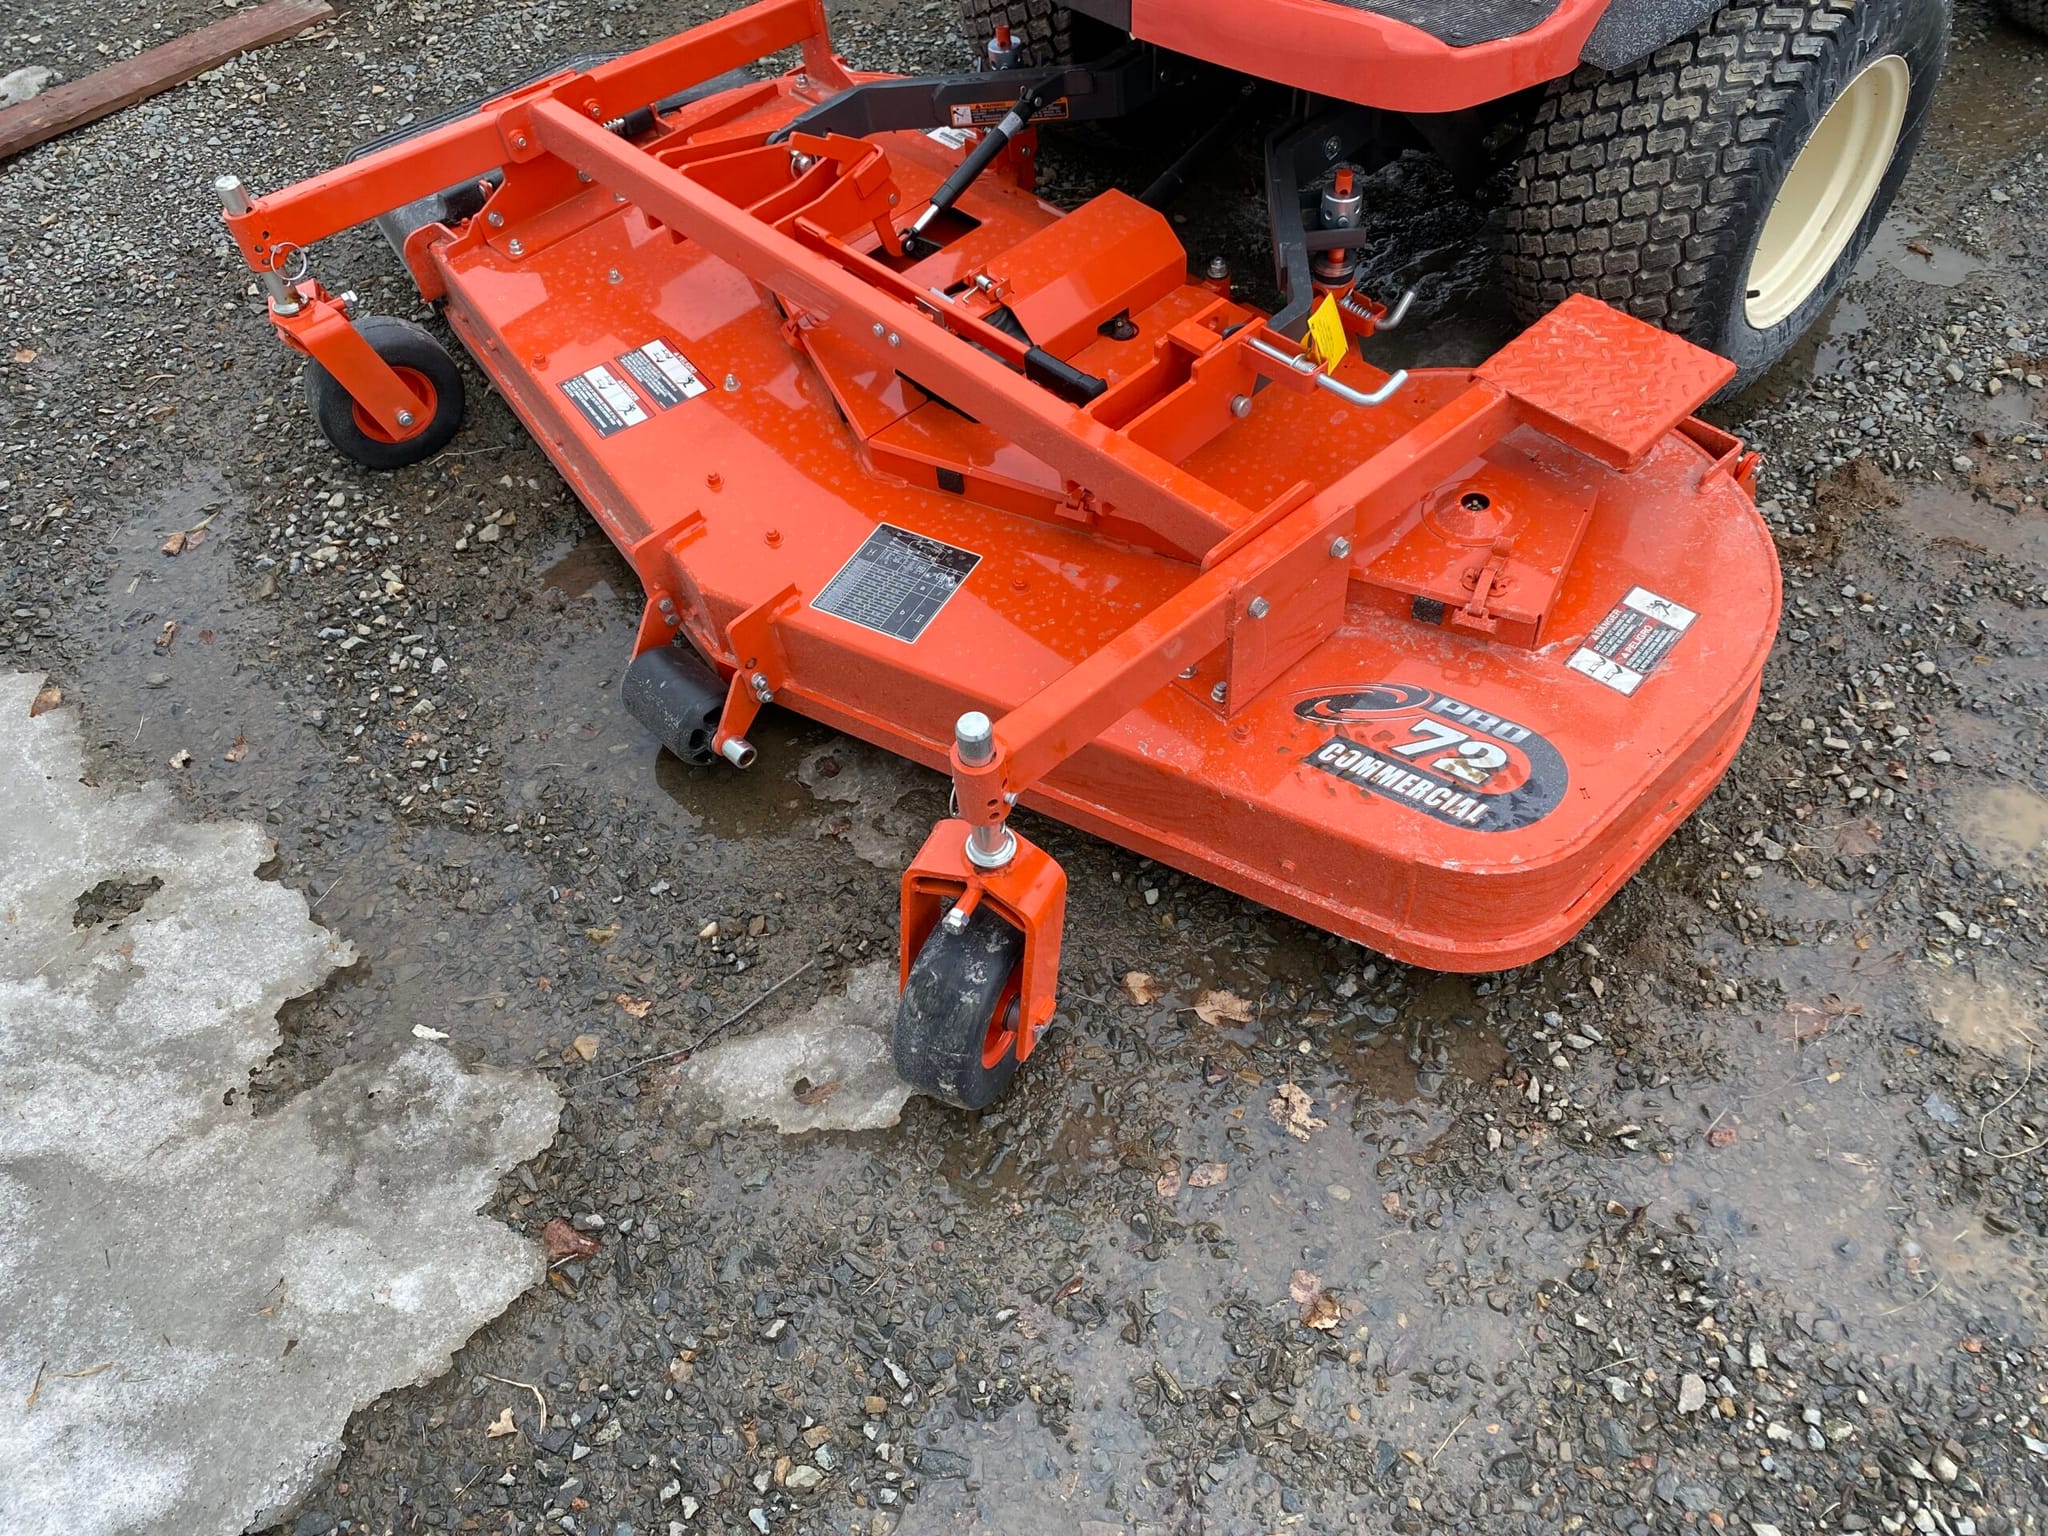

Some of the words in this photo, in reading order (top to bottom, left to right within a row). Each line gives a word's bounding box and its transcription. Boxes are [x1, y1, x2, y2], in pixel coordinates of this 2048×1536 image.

[1592, 607, 1622, 636] DANGER
[1623, 623, 1654, 653] PELIGRO
[1429, 697, 1532, 743] PRO
[1390, 717, 1509, 785] 72
[1317, 742, 1490, 824] COMMERCIAL
